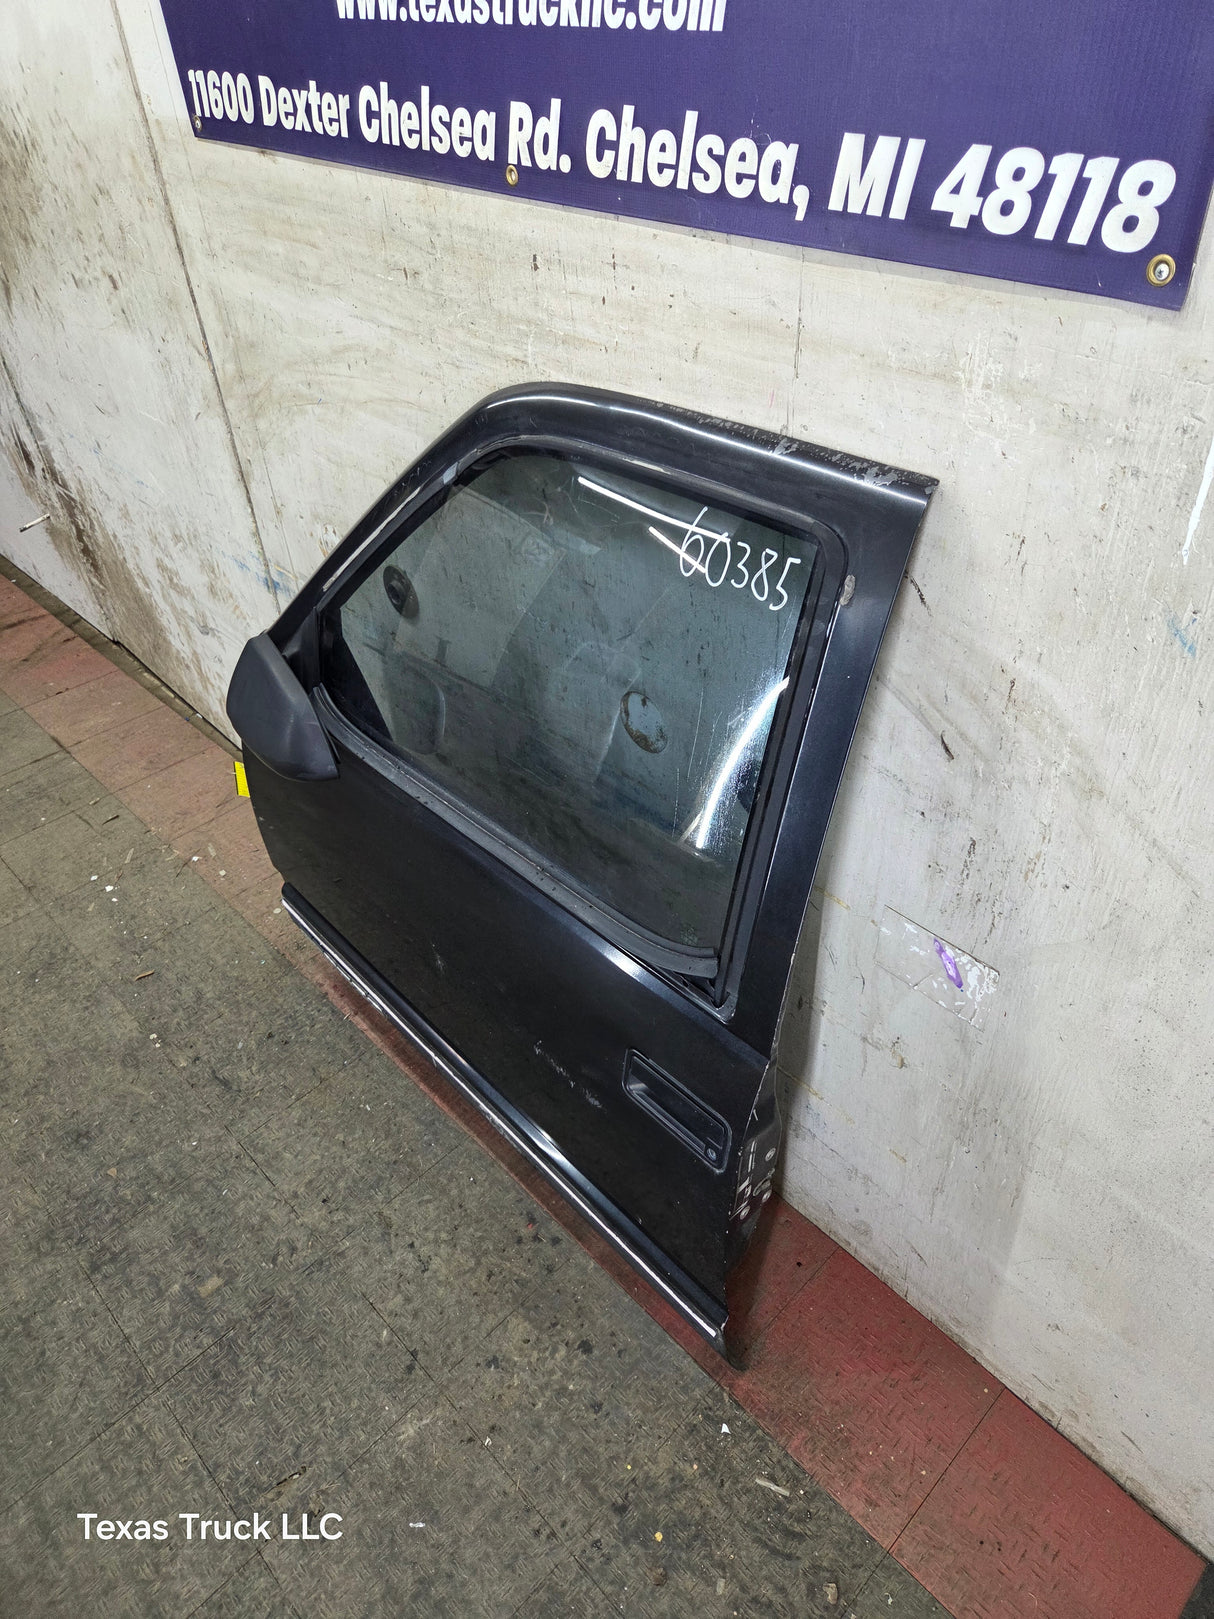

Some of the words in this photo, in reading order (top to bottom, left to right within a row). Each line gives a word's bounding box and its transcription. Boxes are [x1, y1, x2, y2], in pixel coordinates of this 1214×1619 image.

[187, 69, 255, 124] 11600
[257, 74, 350, 139] Dexter
[358, 81, 497, 162] Chelsea
[507, 97, 572, 174] Rd.
[585, 104, 810, 222] Chelsea,
[827, 131, 927, 221] MI
[930, 143, 1177, 254] 48118
[679, 505, 802, 611] 60385
